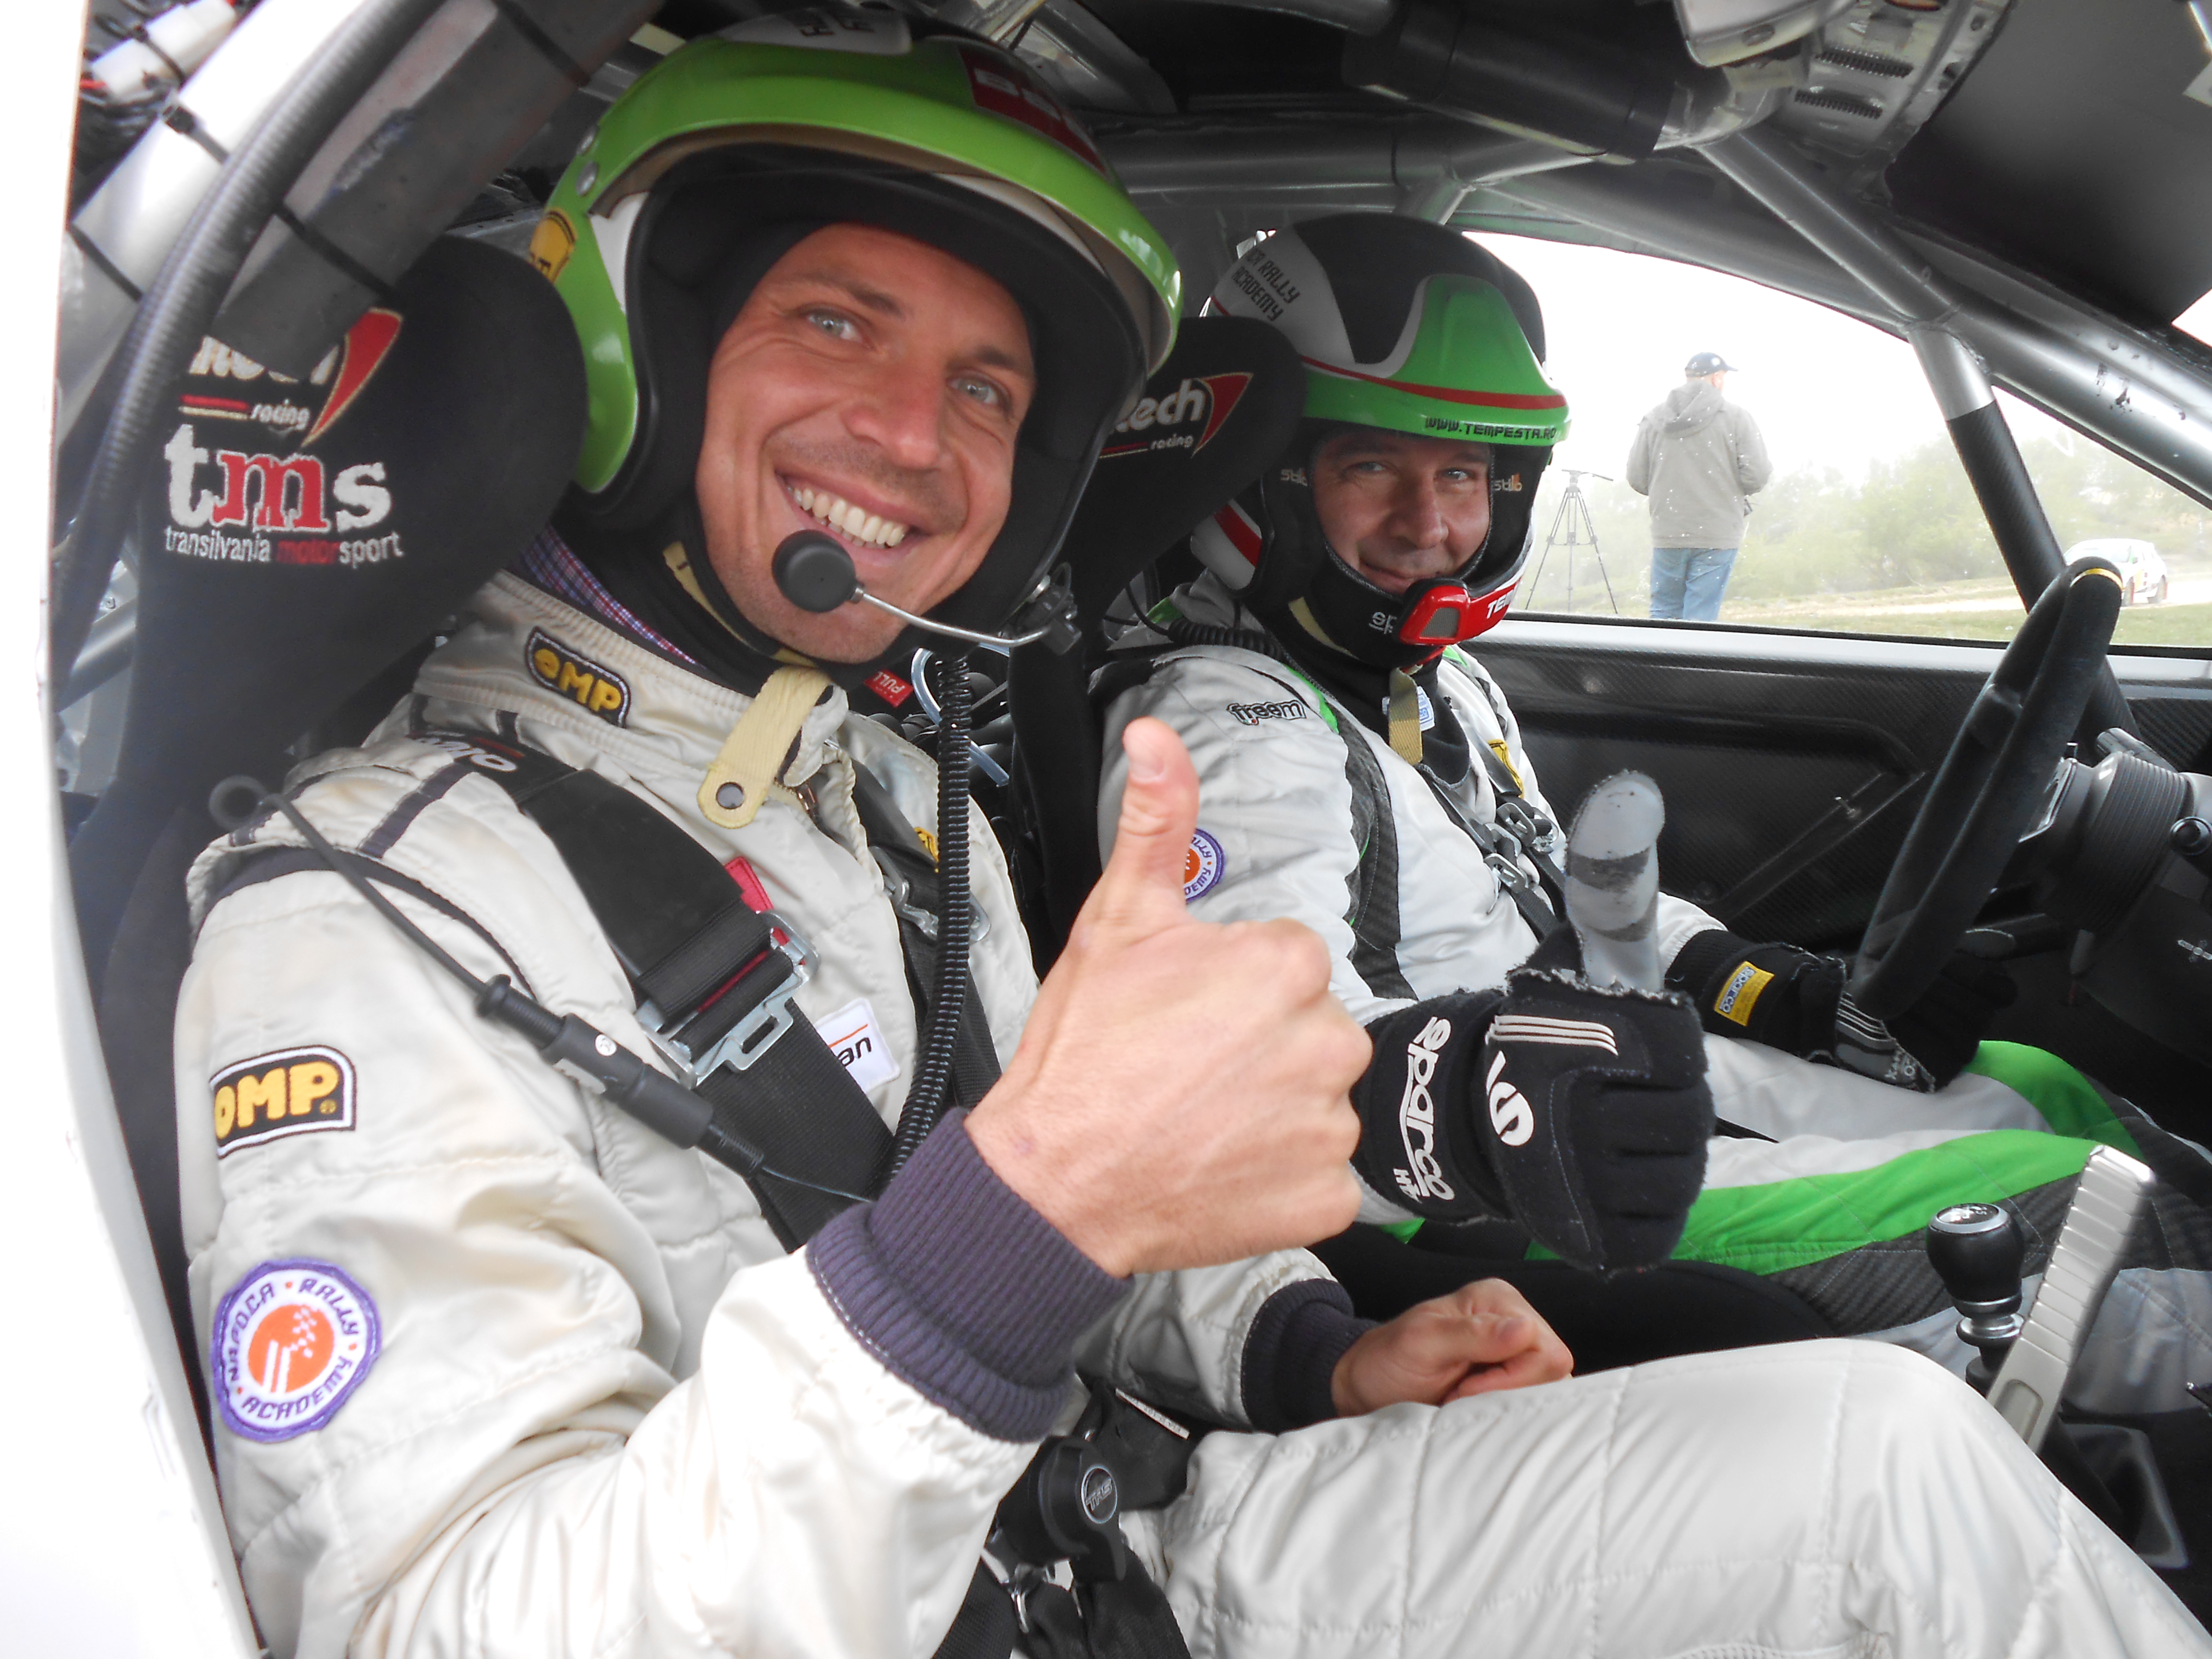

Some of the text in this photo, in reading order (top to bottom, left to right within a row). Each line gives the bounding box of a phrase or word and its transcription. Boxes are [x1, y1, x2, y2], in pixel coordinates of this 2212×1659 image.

[1231, 265, 1284, 321] ACADEMY
[1257, 260, 1300, 303] RALLY
[250, 398, 310, 430] racing
[1116, 378, 1205, 431] ech
[1151, 433, 1194, 449] racing
[164, 423, 392, 532] tms
[165, 525, 272, 563] transilvania
[533, 648, 622, 711] OMP
[1230, 702, 1303, 721] freem
[214, 1061, 339, 1140] OMP
[1399, 1016, 1455, 1201] sparco
[228, 1278, 359, 1382] NAPOCA RALLY
[241, 1355, 353, 1421] ACADEMY
